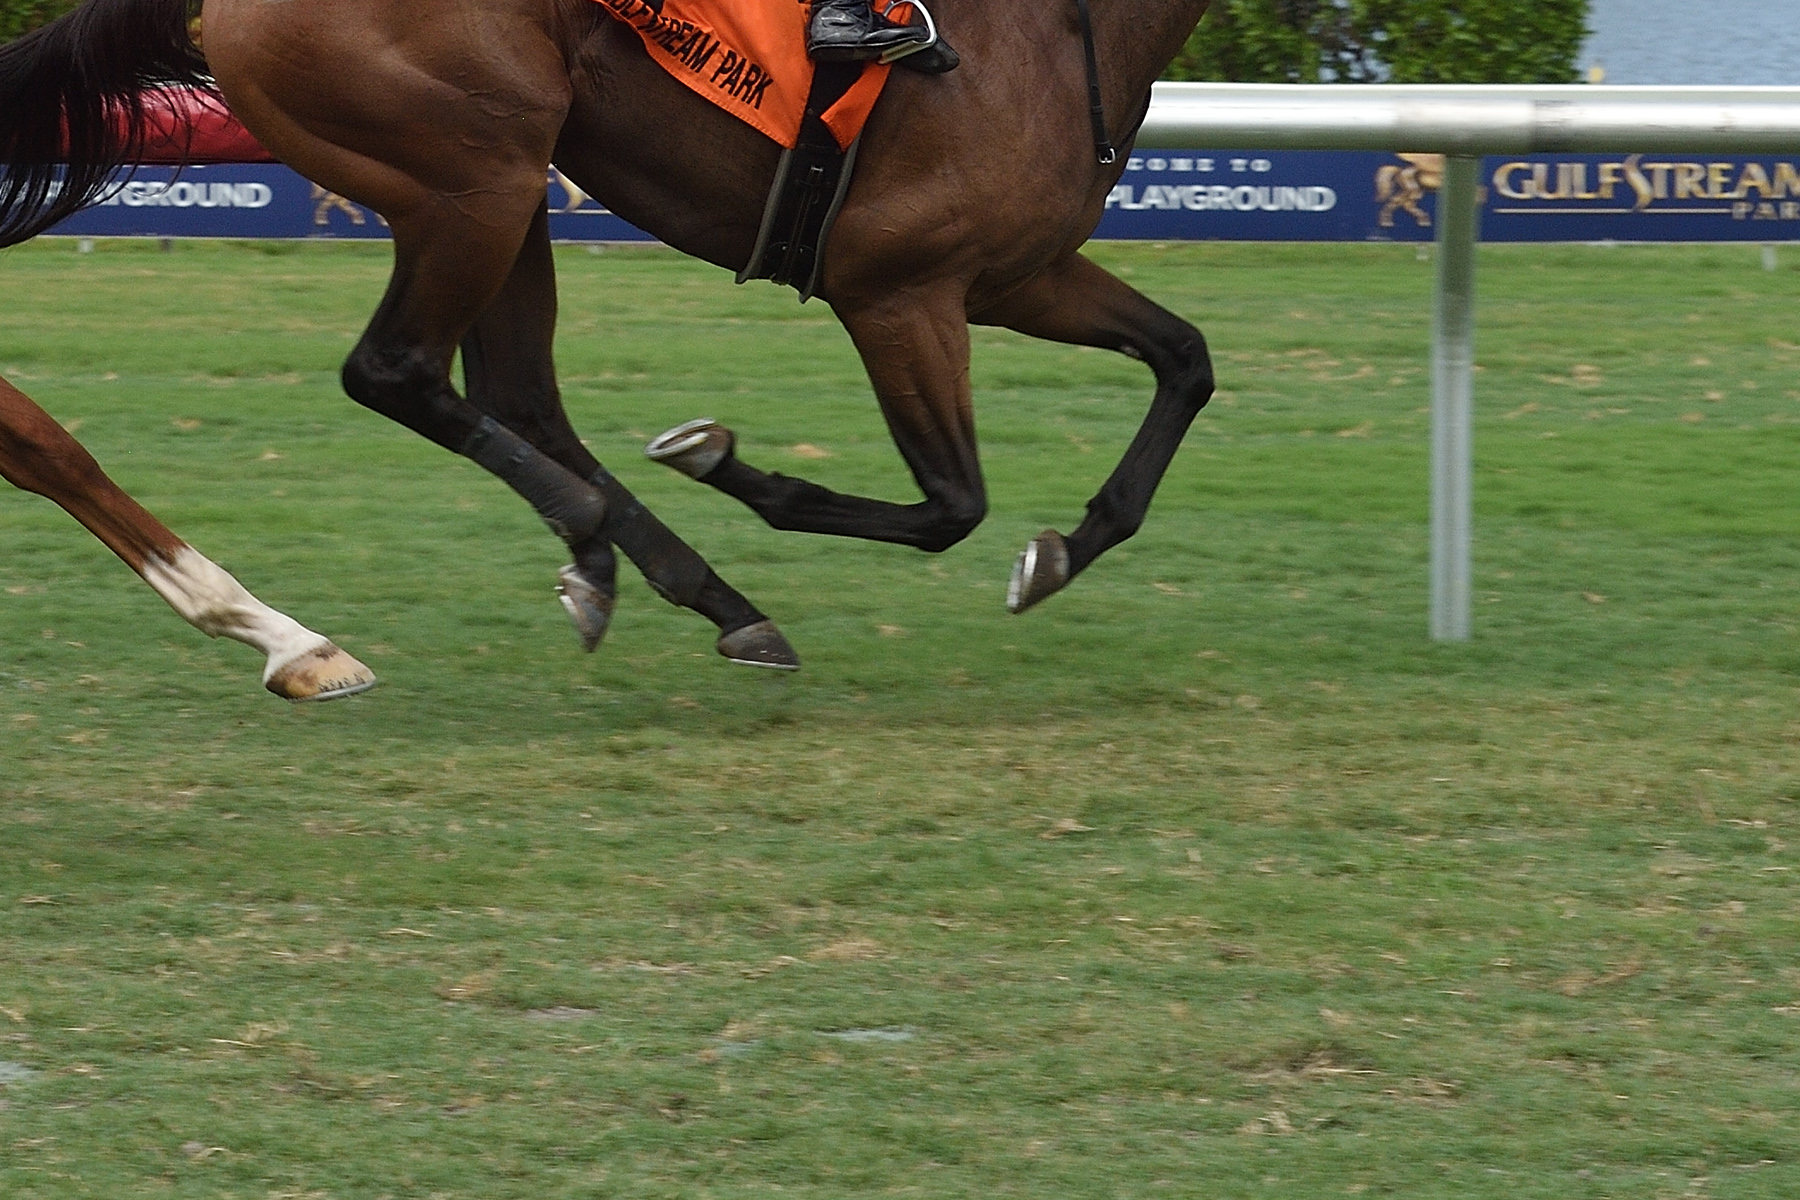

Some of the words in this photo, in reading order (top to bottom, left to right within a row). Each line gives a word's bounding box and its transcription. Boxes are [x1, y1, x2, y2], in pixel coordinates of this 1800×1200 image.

[709, 49, 774, 110] PARK
[1124, 157, 1215, 172] COME
[1229, 158, 1272, 173] TO
[1492, 153, 1800, 212] GULFSTREAM
[1104, 185, 1337, 211] PLAYGROUND
[1732, 201, 1800, 220] PAR
